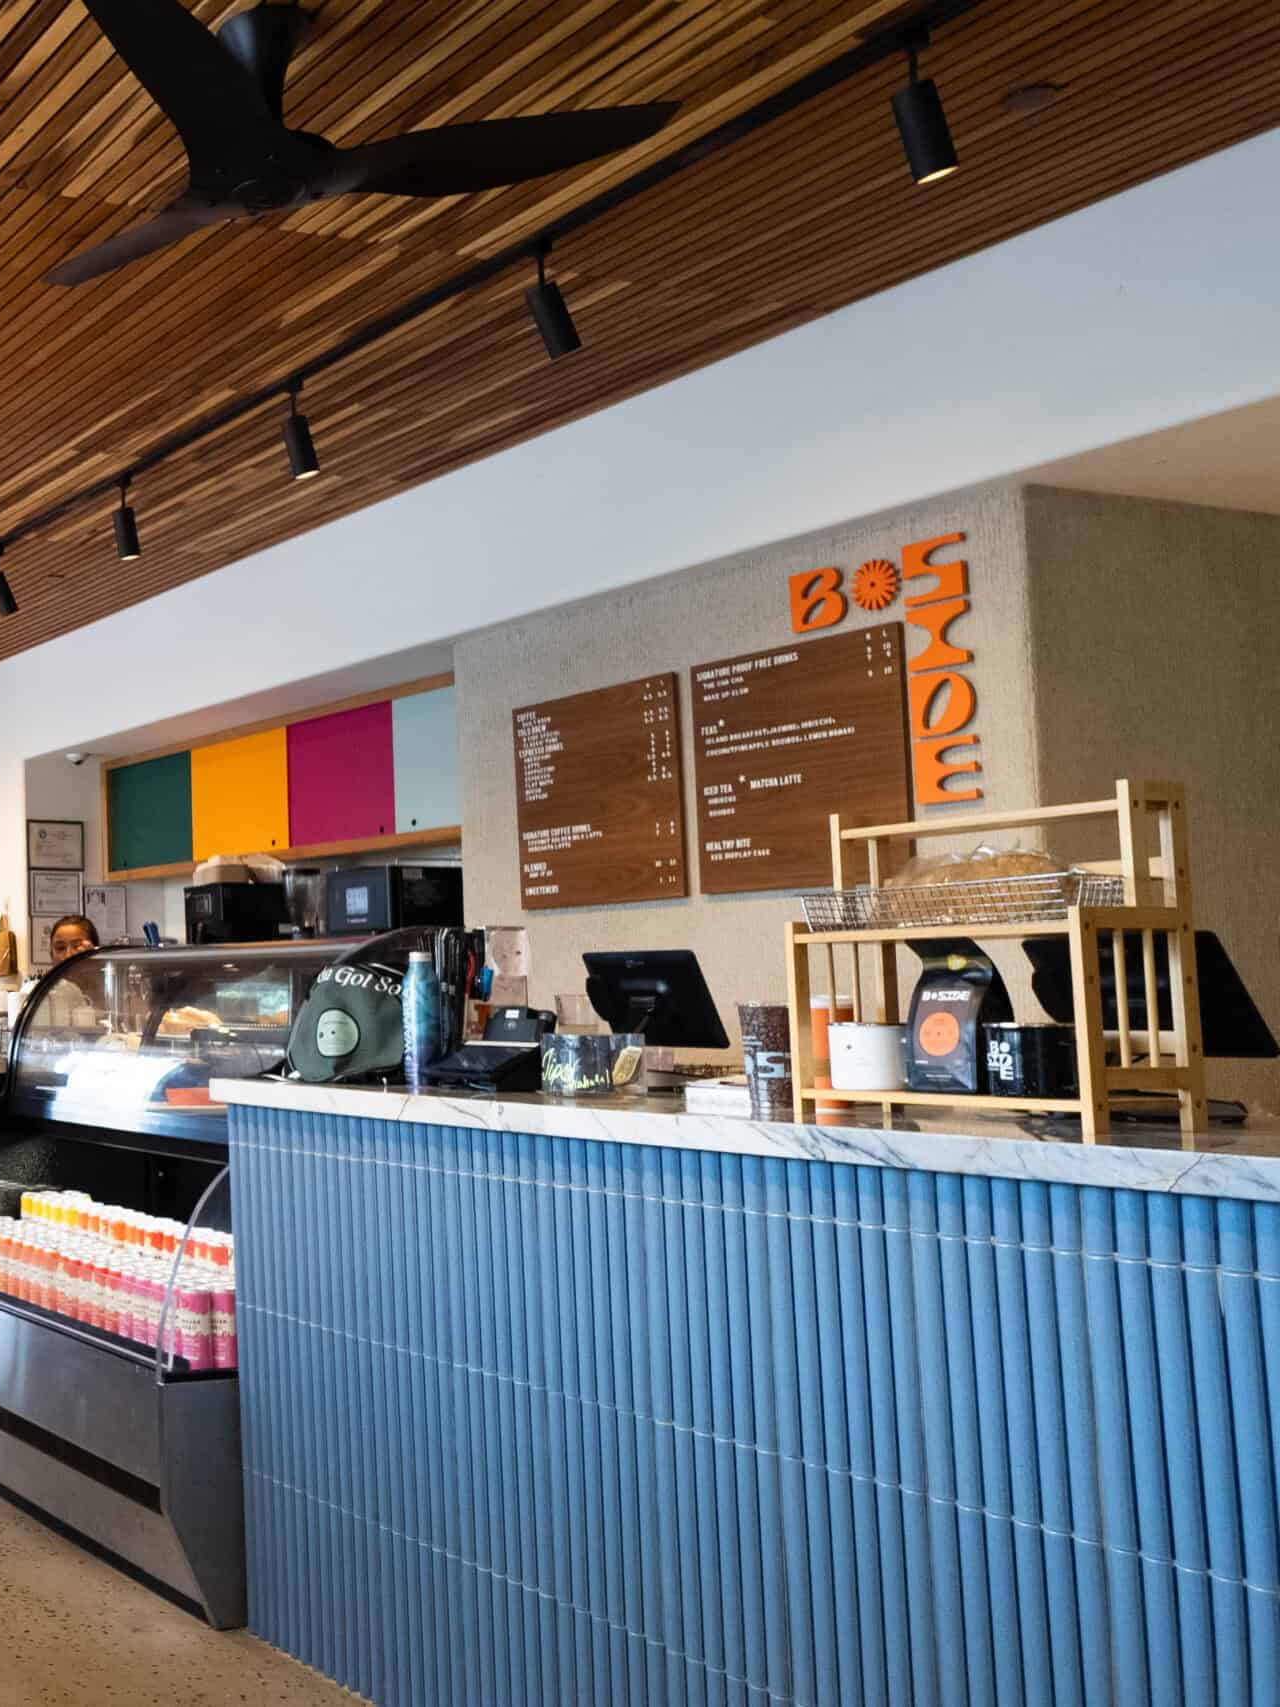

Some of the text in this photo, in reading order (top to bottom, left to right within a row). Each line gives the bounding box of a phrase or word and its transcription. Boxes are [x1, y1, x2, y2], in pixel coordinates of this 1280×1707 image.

[696, 651, 799, 682] SIGNATURE PROOF FREE DRINKS
[720, 783, 733, 793] TEA
[750, 773, 802, 790] MATCHA LATTE
